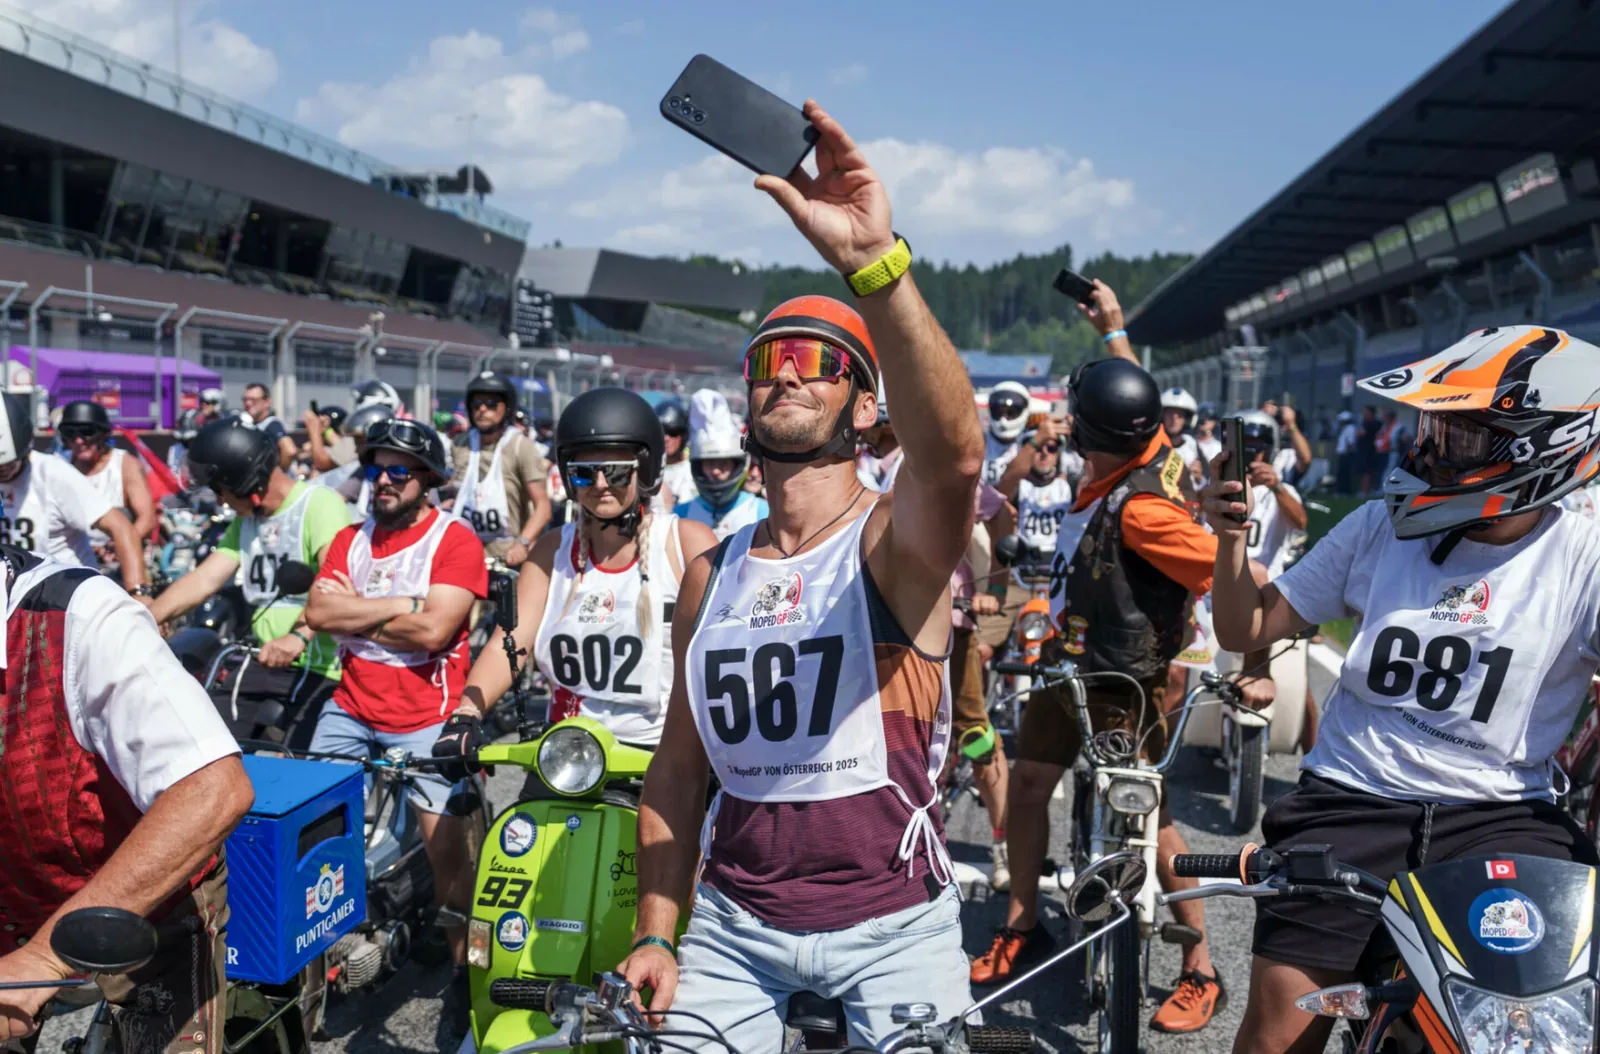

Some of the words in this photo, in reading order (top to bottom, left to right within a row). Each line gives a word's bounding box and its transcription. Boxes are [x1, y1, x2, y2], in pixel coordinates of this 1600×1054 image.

[549, 633, 643, 695] 602
[1366, 626, 1515, 725] 681
[704, 634, 845, 745] 567
[1402, 710, 1418, 726] VON
[1417, 720, 1465, 746] ÖSTERREICH
[1464, 740, 1488, 751] 2025
[763, 764, 782, 777] VON
[782, 762, 833, 776] ÖSTERREICH
[835, 757, 859, 771] 2025
[488, 854, 529, 875] Vespa
[1496, 863, 1510, 875] D
[476, 875, 534, 910] 93
[295, 898, 356, 954] PUNTIGAMER
[538, 920, 580, 931] PIAGGIO
